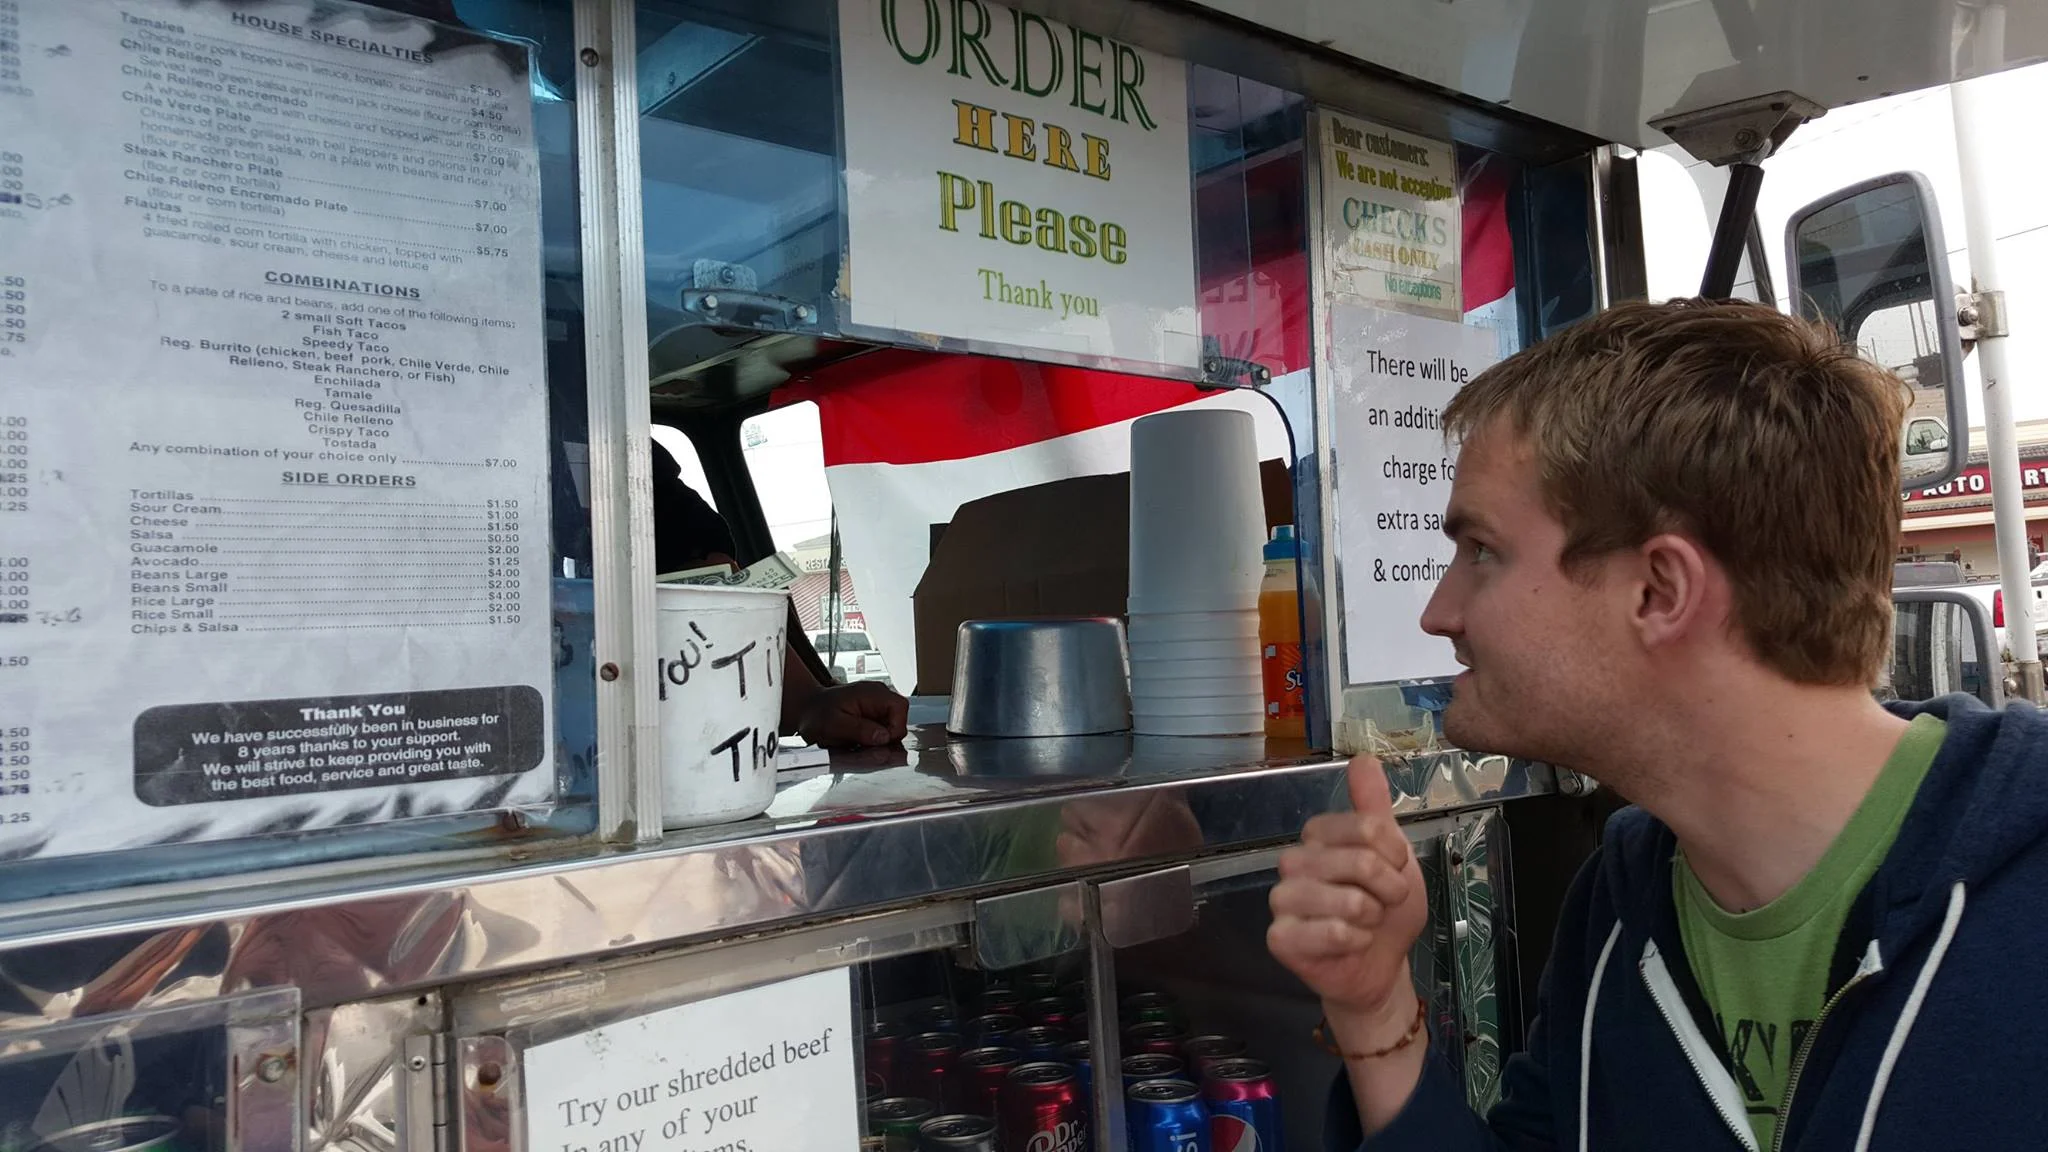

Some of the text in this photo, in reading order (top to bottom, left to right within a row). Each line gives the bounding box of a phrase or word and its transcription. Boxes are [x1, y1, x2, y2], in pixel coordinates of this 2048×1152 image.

[232, 12, 434, 63] HOUSE SPECIALTIES
[881, 0, 1158, 131] ORDER
[952, 99, 1111, 181] HERE
[1332, 117, 1363, 149] Dear
[124, 143, 507, 211] Steak Ranchero Plate $7.00
[1335, 151, 1354, 181] We
[1358, 165, 1376, 186] are
[1379, 168, 1399, 191] not
[124, 169, 165, 185] Chile
[169, 177, 225, 194] Relleno
[314, 199, 348, 212] Plate
[475, 223, 507, 234] $7.00
[124, 196, 508, 257] Flautas $5.75
[937, 171, 1127, 264] Please
[1343, 197, 1446, 248] CHECKS
[265, 271, 421, 298] COMBINATIONS
[978, 268, 1098, 320] Thank you
[281, 310, 407, 331] 2 small Soft Tacos
[313, 325, 379, 340] Fish Taco
[161, 336, 194, 350] Reg.
[200, 339, 251, 353] Burrito
[256, 344, 320, 361] (chicken,
[361, 355, 396, 367] pork,
[399, 357, 432, 370] Chile
[435, 360, 475, 375] Verde,
[478, 364, 510, 376] Chile
[302, 337, 390, 353] Speedy Taco
[229, 355, 456, 384] Relleno, Steak Ranchero, or Fish)
[1366, 350, 1468, 384] There will be
[314, 375, 381, 389] Enchilada
[325, 388, 373, 400] Tamale
[295, 398, 401, 414] Reg. Quesadilla
[1368, 407, 1389, 426] an
[304, 411, 394, 426] Chile Relleno
[308, 424, 390, 438] Crispy Taco
[322, 437, 377, 449] Tostada
[130, 441, 517, 468] Any combination of your choice only $7.00
[282, 472, 417, 486] SIDE ORDERS
[1383, 455, 1437, 485] charge
[130, 489, 518, 509] Tortillas $1.50
[130, 502, 519, 520] Sour Cream $1.00
[1377, 509, 1419, 530] extra
[130, 516, 519, 532] Cheese $1.50
[130, 529, 519, 543] Salsa $0.50
[130, 543, 519, 554] Guacamole $2.00
[131, 556, 520, 567] Avocado $1.25
[1373, 558, 1387, 582] &
[131, 568, 520, 582] Beans Large $4.00
[131, 580, 520, 593] Beans Small $2.00
[131, 592, 520, 608] Rice Large $4.00
[131, 603, 520, 620] Rice Small $2.00
[131, 615, 520, 636] Chips & Salsa $1.50
[299, 704, 406, 721] Thank You
[191, 713, 500, 745] We have successfully been in business for
[238, 731, 461, 759] 8 years thanks to your support.
[202, 742, 491, 776] We will strive to keep providing you with
[211, 758, 485, 791] the best food, service and great taste.
[558, 1027, 833, 1127] Try our shredded beef
[662, 1107, 691, 1140] of
[703, 1096, 758, 1134] your
